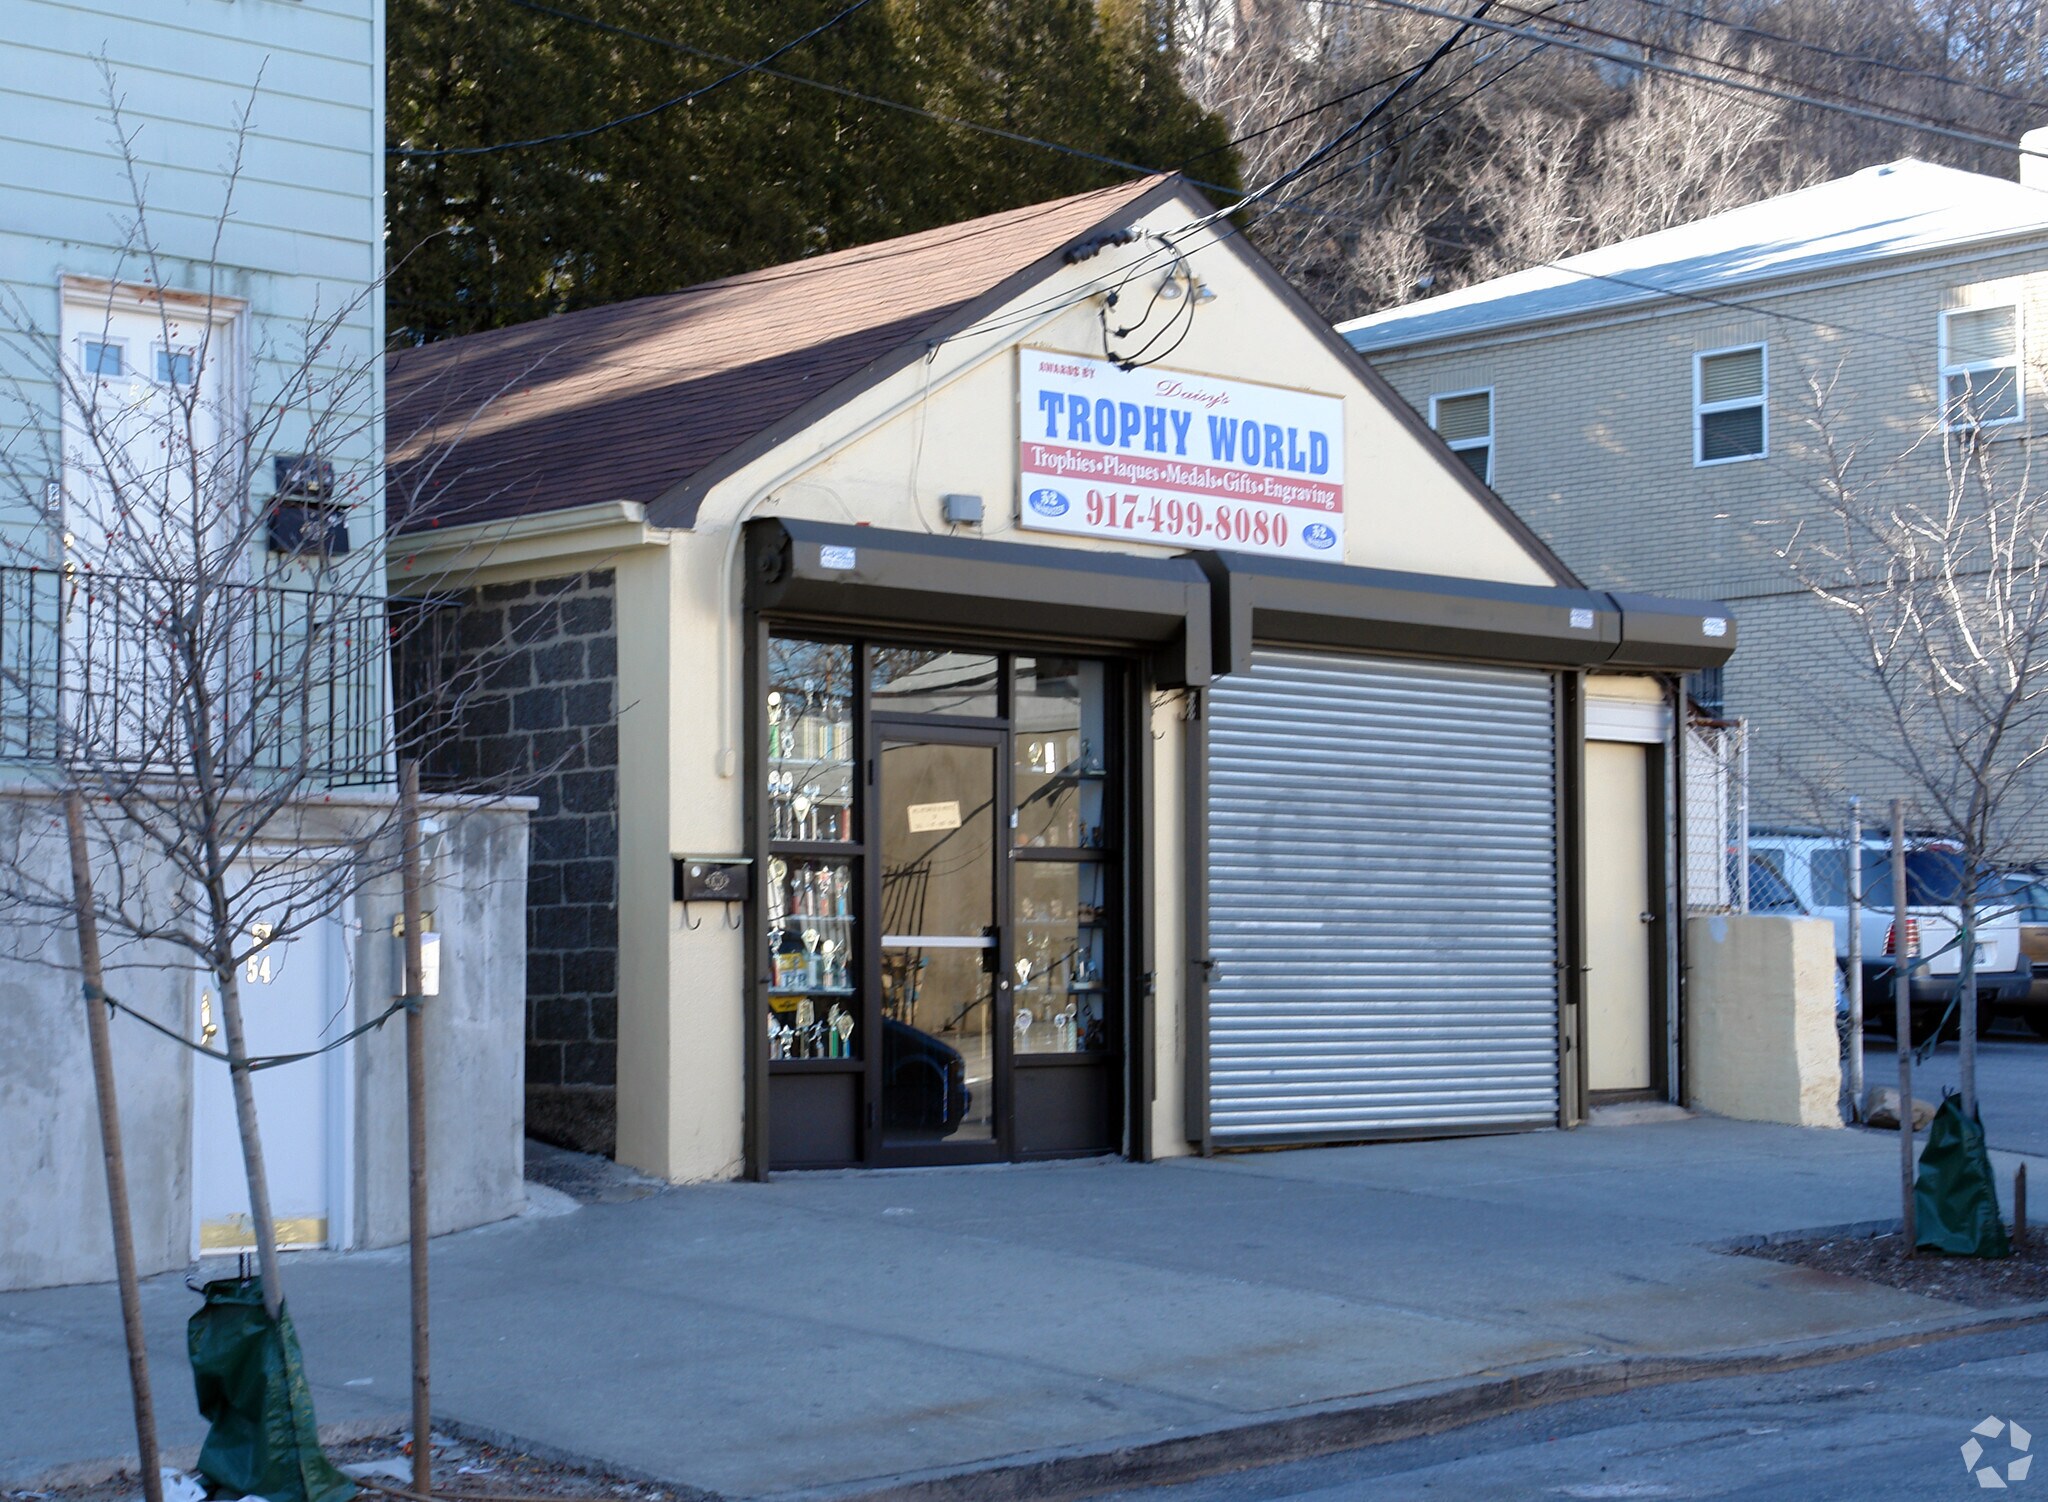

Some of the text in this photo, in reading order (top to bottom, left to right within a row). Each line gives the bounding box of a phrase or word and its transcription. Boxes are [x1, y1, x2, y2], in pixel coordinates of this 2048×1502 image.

[1082, 367, 1096, 379] BY
[1154, 380, 1230, 409] Daisy's
[1039, 389, 1328, 475] TROPHY WORLD
[1263, 477, 1336, 510] Engraving
[1086, 489, 1288, 548] 917-499-8080
[246, 954, 271, 984] 54
